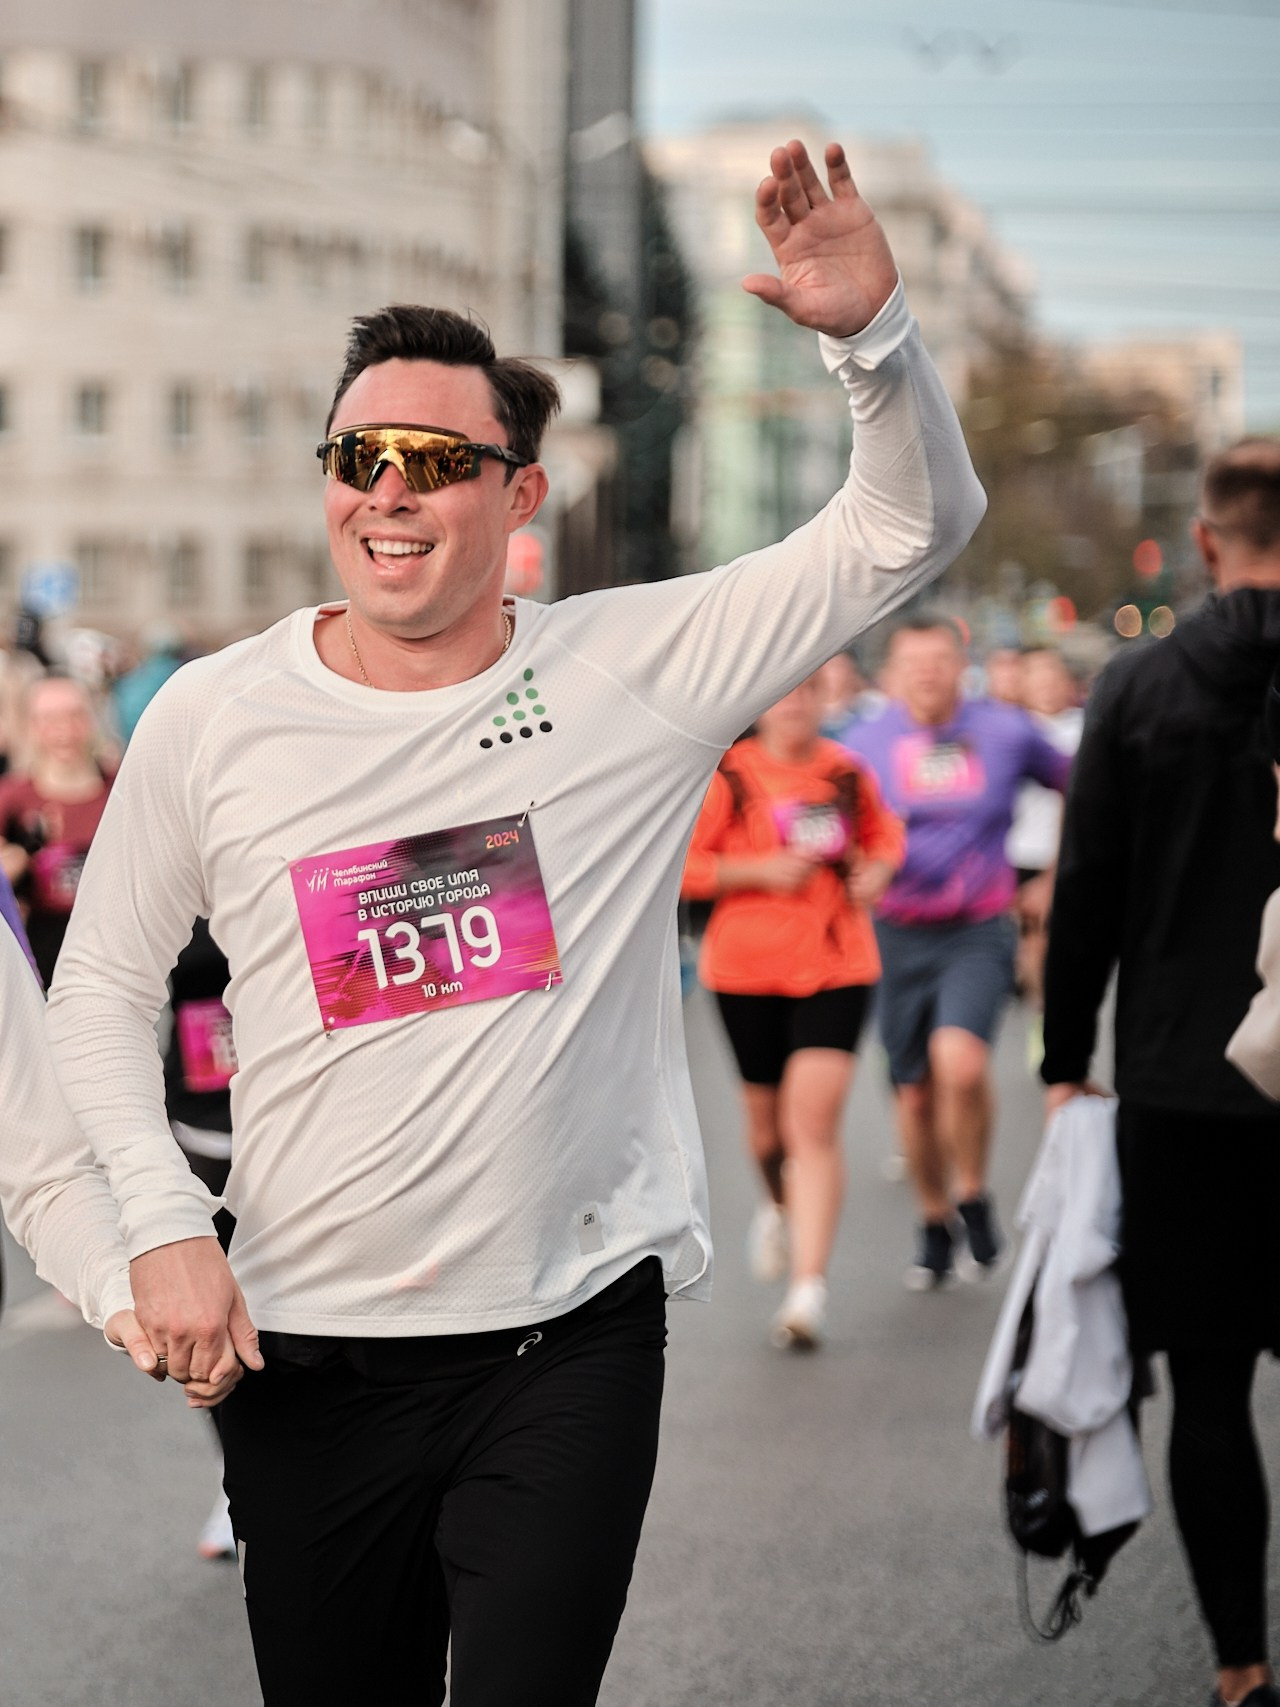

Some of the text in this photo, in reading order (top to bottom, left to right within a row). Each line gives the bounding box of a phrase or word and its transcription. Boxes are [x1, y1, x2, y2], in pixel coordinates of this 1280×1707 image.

[485, 829, 520, 850] 2024
[331, 859, 388, 878] Челябинский
[333, 872, 377, 887] Марафон
[358, 868, 480, 905] ВПИШИ СВОЕ ИМЯ
[357, 883, 491, 922] В ИСТОРИЮ ГОРОДА
[357, 905, 502, 990] 1379
[421, 983, 437, 998] 10
